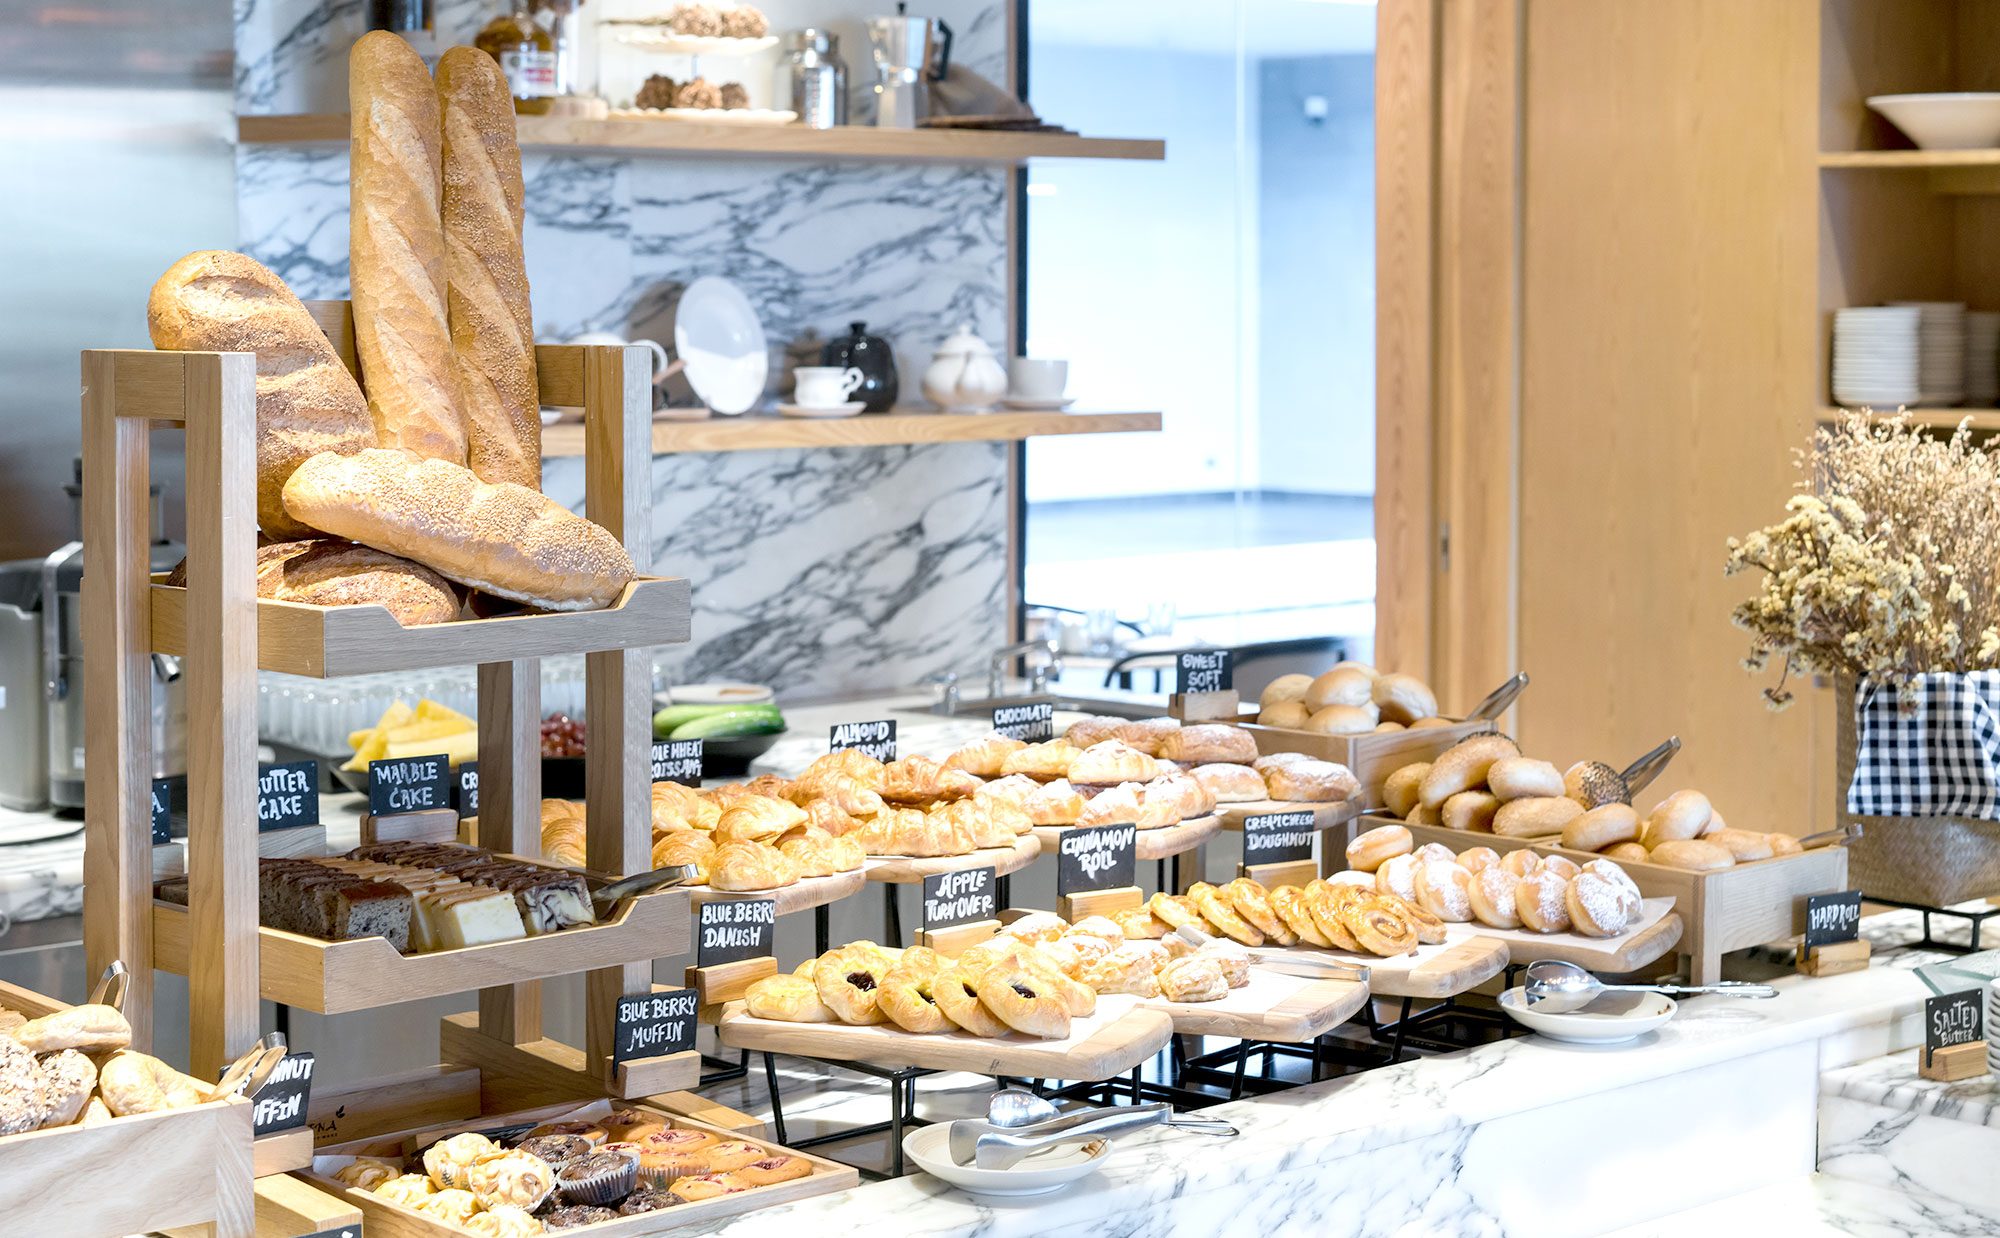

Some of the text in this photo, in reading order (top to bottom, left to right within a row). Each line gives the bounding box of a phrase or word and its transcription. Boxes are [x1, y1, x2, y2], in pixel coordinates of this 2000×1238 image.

[1182, 651, 1228, 669] SWEET
[1187, 670, 1222, 687] SOFT
[994, 704, 1052, 725] CHOCOLATE
[831, 722, 889, 746] ALMOND
[652, 738, 703, 761] OLE WHEAT
[258, 769, 310, 796] UTTER
[374, 761, 438, 785] MARBLE
[258, 795, 302, 820] CAKE
[389, 786, 433, 809] CAKE
[1061, 827, 1135, 857] CINNAMON
[1247, 831, 1314, 850] DOUGHNUT
[1078, 850, 1117, 879] ROLL
[935, 871, 987, 899] APPLE
[701, 902, 775, 925] BLUE BERRY
[925, 895, 994, 922] TURNOVER
[704, 926, 761, 948] DANISH
[620, 996, 696, 1023] BLUE BERRY
[1933, 1000, 1978, 1035] SALTED
[626, 1020, 685, 1052] MUFFIN
[1941, 1029, 1975, 1046] BUTTER
